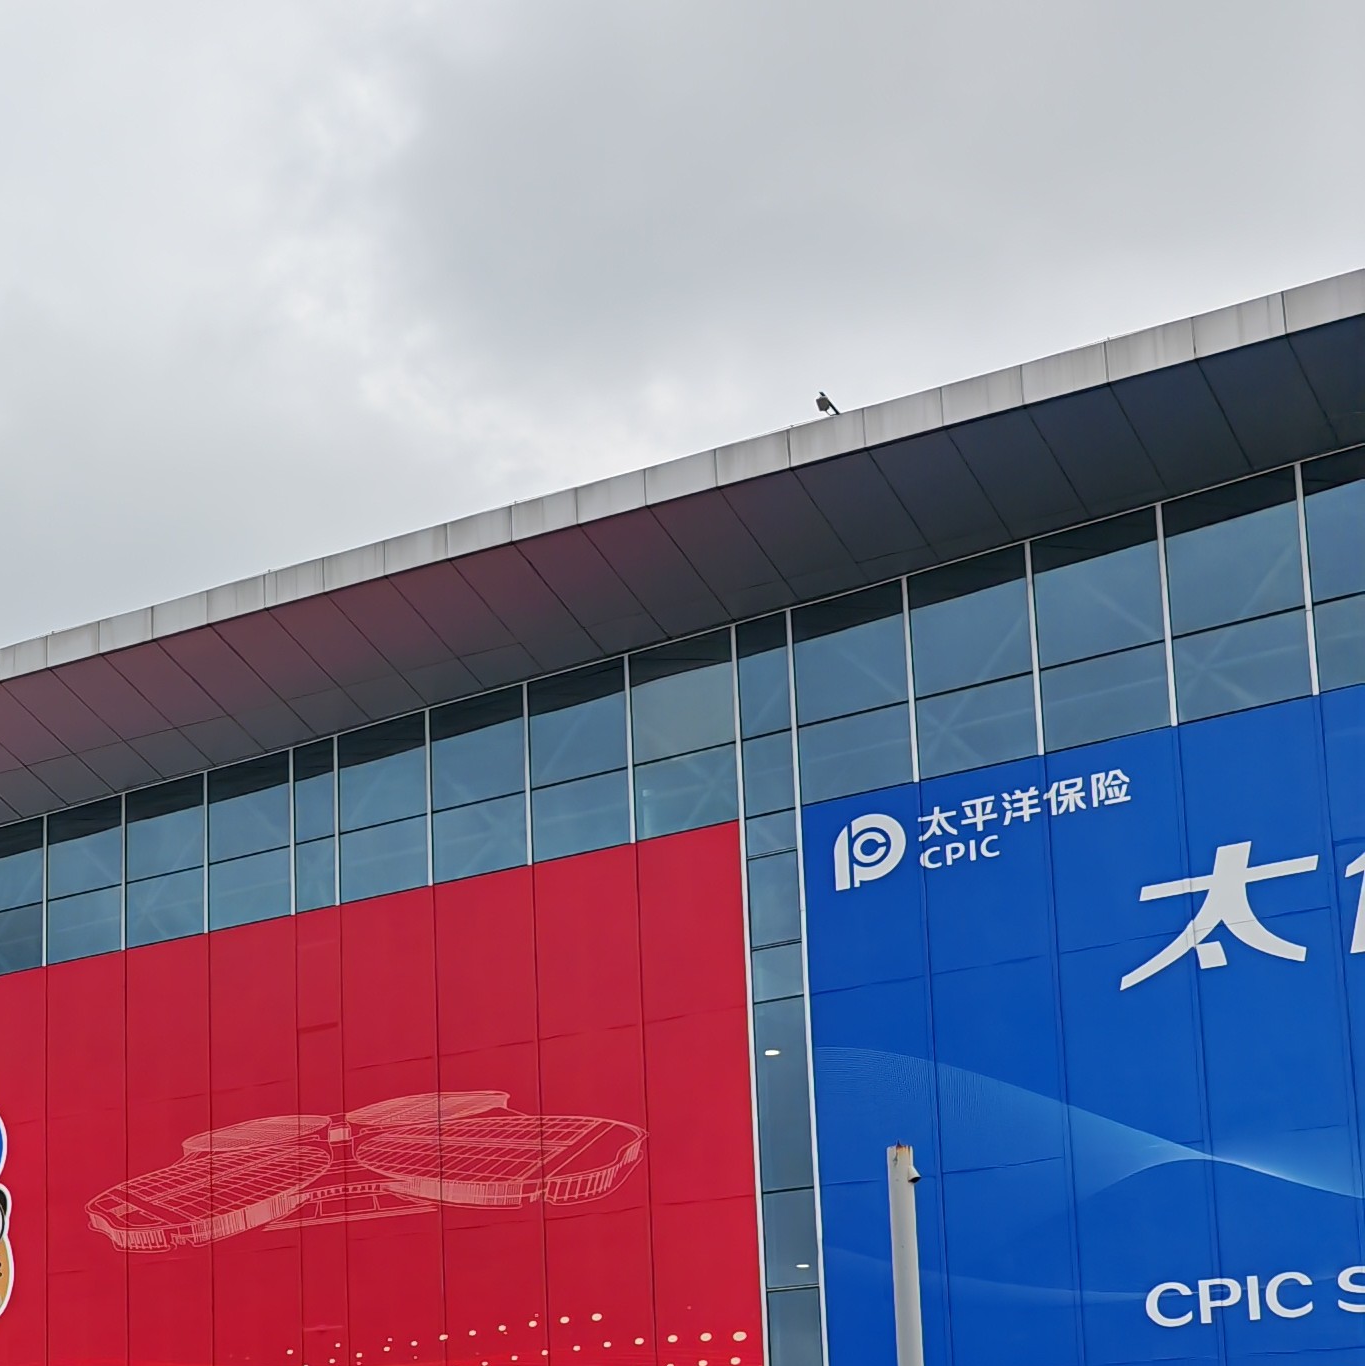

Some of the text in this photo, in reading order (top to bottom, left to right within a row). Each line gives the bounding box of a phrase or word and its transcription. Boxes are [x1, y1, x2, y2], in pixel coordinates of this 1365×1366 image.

[917, 769, 1131, 841] 太平洋保险
[919, 835, 1000, 869] CPIC
[1145, 1271, 1313, 1327] CPIC
